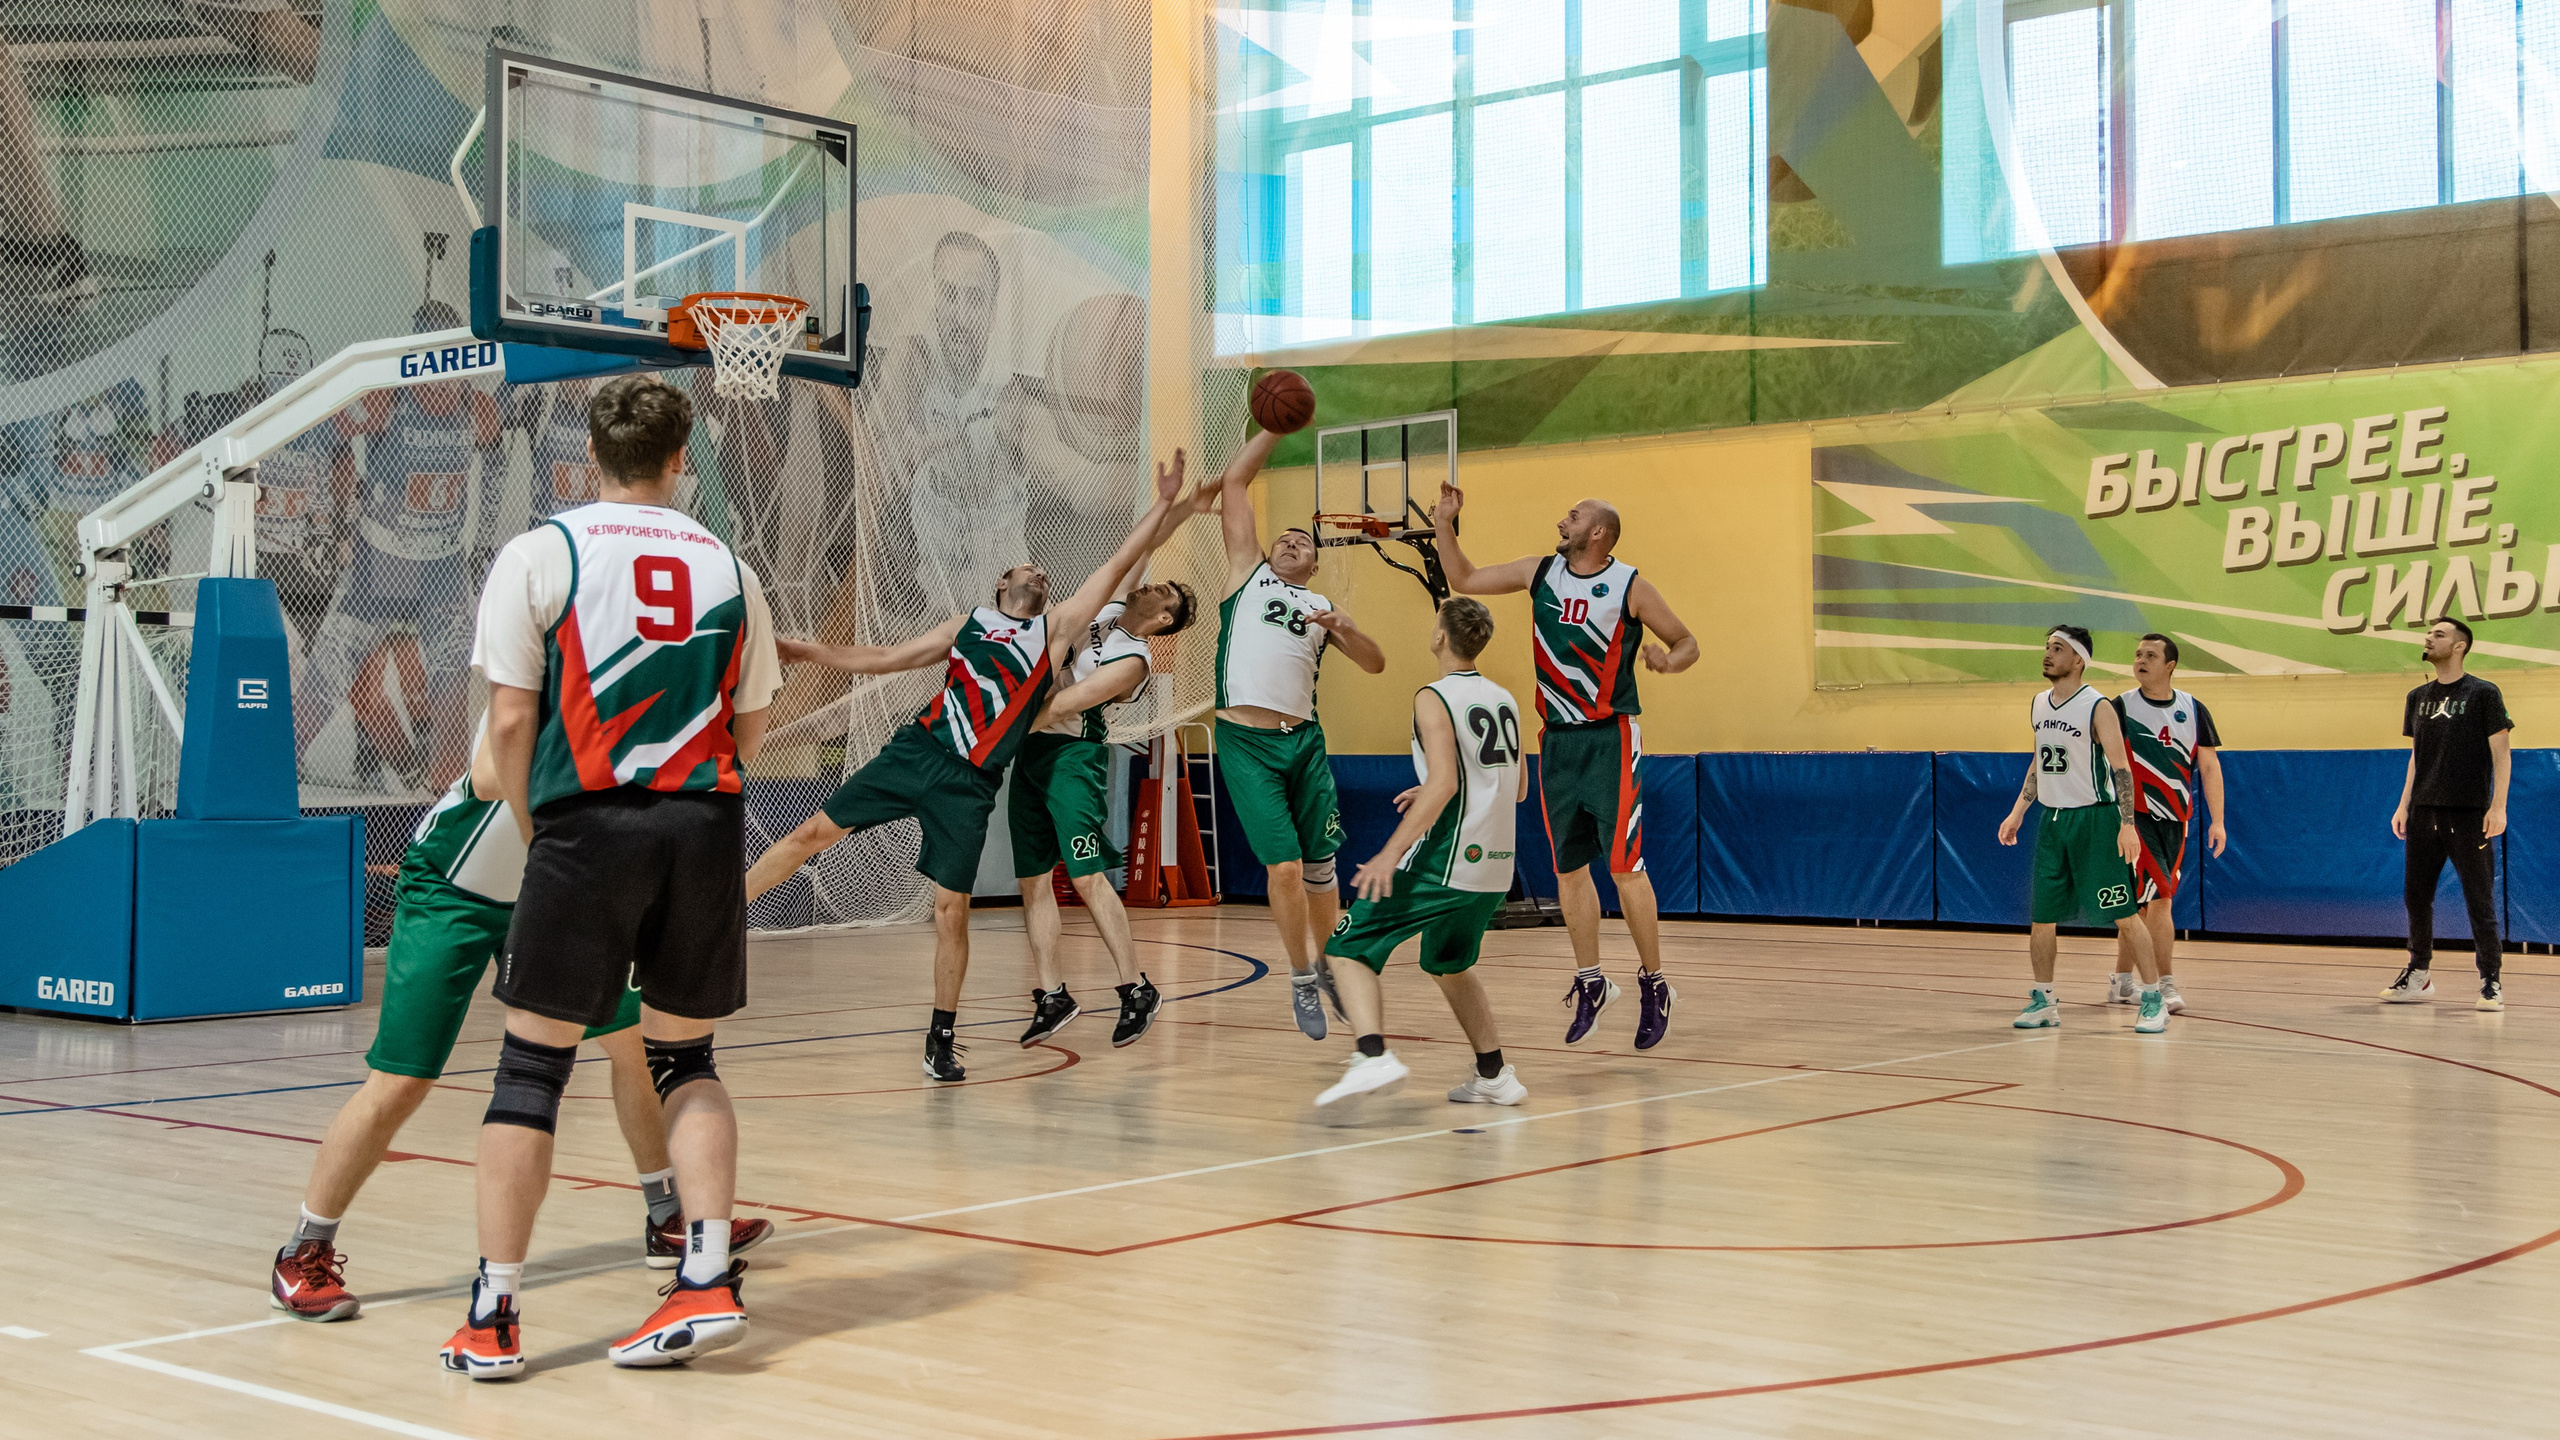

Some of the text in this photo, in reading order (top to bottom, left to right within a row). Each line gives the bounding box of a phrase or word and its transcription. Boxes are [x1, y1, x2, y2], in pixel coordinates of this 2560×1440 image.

[546, 303, 593, 319] GARED
[400, 341, 497, 379] GARED
[2084, 406, 2469, 520] БЫСТРЕЕ,
[587, 524, 720, 551] БЕЛОРУСНЕФТЬ-СИБИРЬ
[2221, 475, 2518, 573] ВЫШЕ,
[633, 554, 693, 643] 9
[1560, 598, 1589, 625] 10
[1261, 597, 1308, 639] 28
[1466, 702, 1520, 768] 20
[2043, 719, 2082, 737] ЯНГПУР
[2158, 726, 2172, 746] 4
[2040, 744, 2069, 774] 23
[1071, 832, 1100, 861] 29
[2098, 885, 2129, 909] 23
[38, 976, 114, 1006] GARED
[284, 983, 344, 998] GARED
